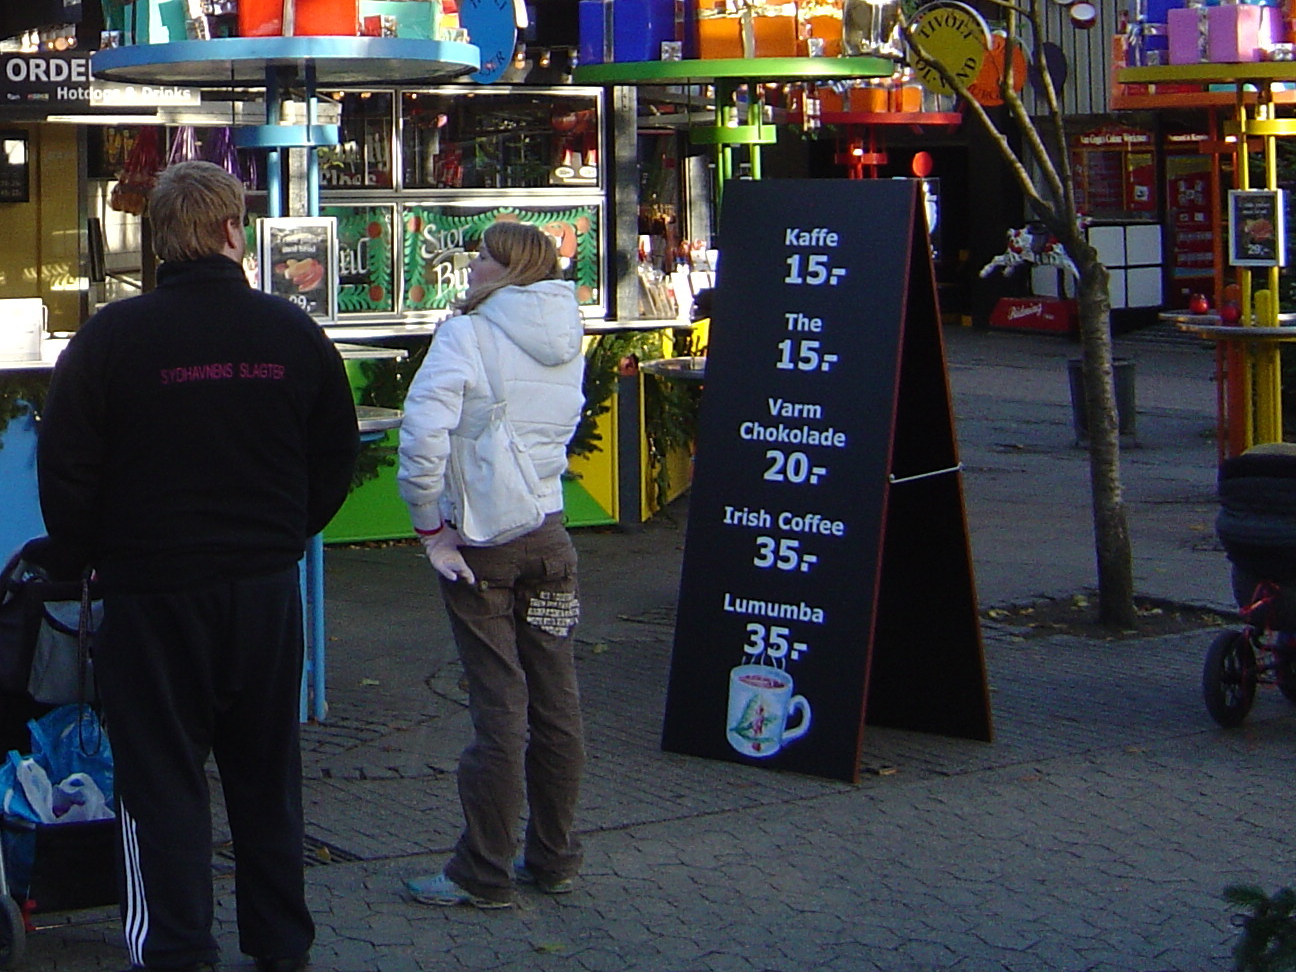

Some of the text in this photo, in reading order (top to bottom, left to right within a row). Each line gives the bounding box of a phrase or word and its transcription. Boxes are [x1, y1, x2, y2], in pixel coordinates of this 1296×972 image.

[918, 13, 973, 39] TIVOLI
[785, 228, 839, 247] Kaffe
[785, 313, 823, 332] The
[240, 362, 286, 380] SLAGTER
[768, 398, 822, 419] Varm
[739, 422, 846, 447] Chokolade
[723, 506, 845, 536] Irish Coffee
[723, 593, 825, 624] Lumumba
